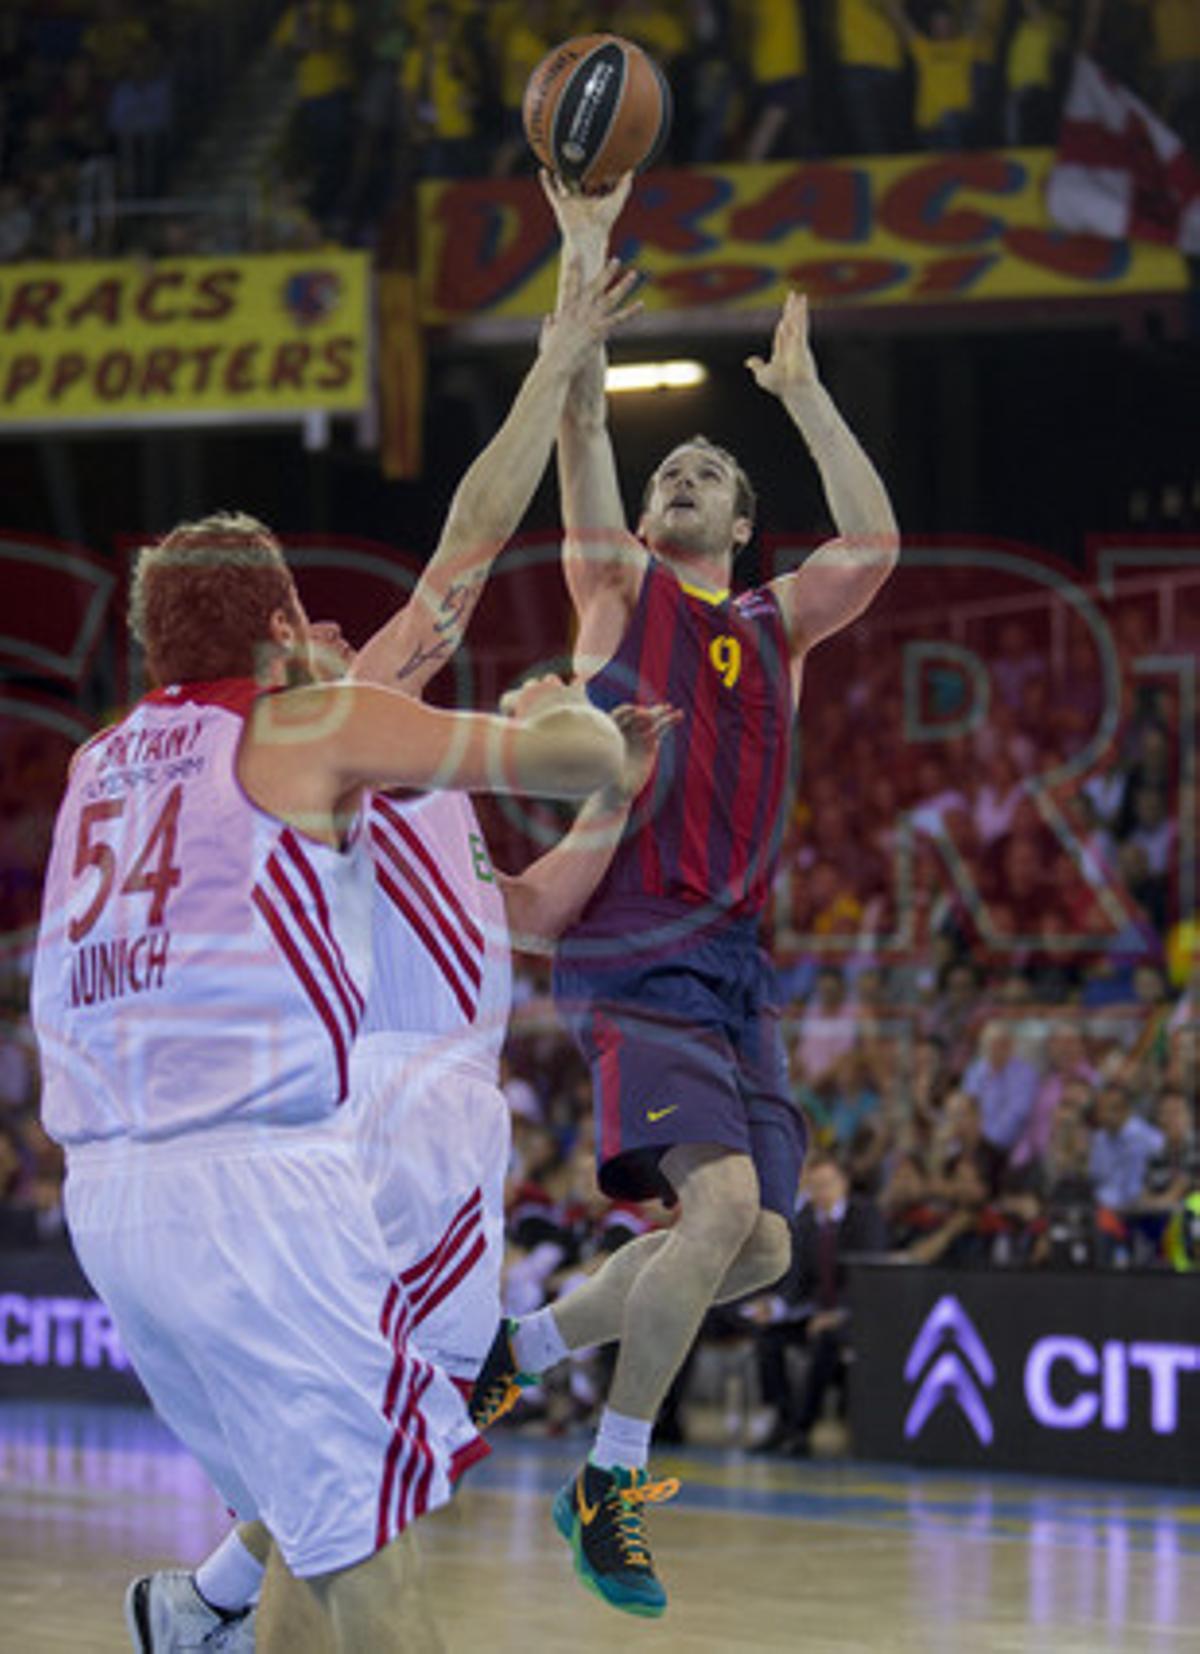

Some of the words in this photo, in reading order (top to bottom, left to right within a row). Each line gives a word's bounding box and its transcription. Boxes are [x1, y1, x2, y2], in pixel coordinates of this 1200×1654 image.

[2, 335, 356, 408] PPORTERS
[708, 634, 741, 688] 9
[68, 782, 183, 943] 54
[0, 1291, 129, 1370] CITR
[1024, 1334, 1200, 1435] CIT
